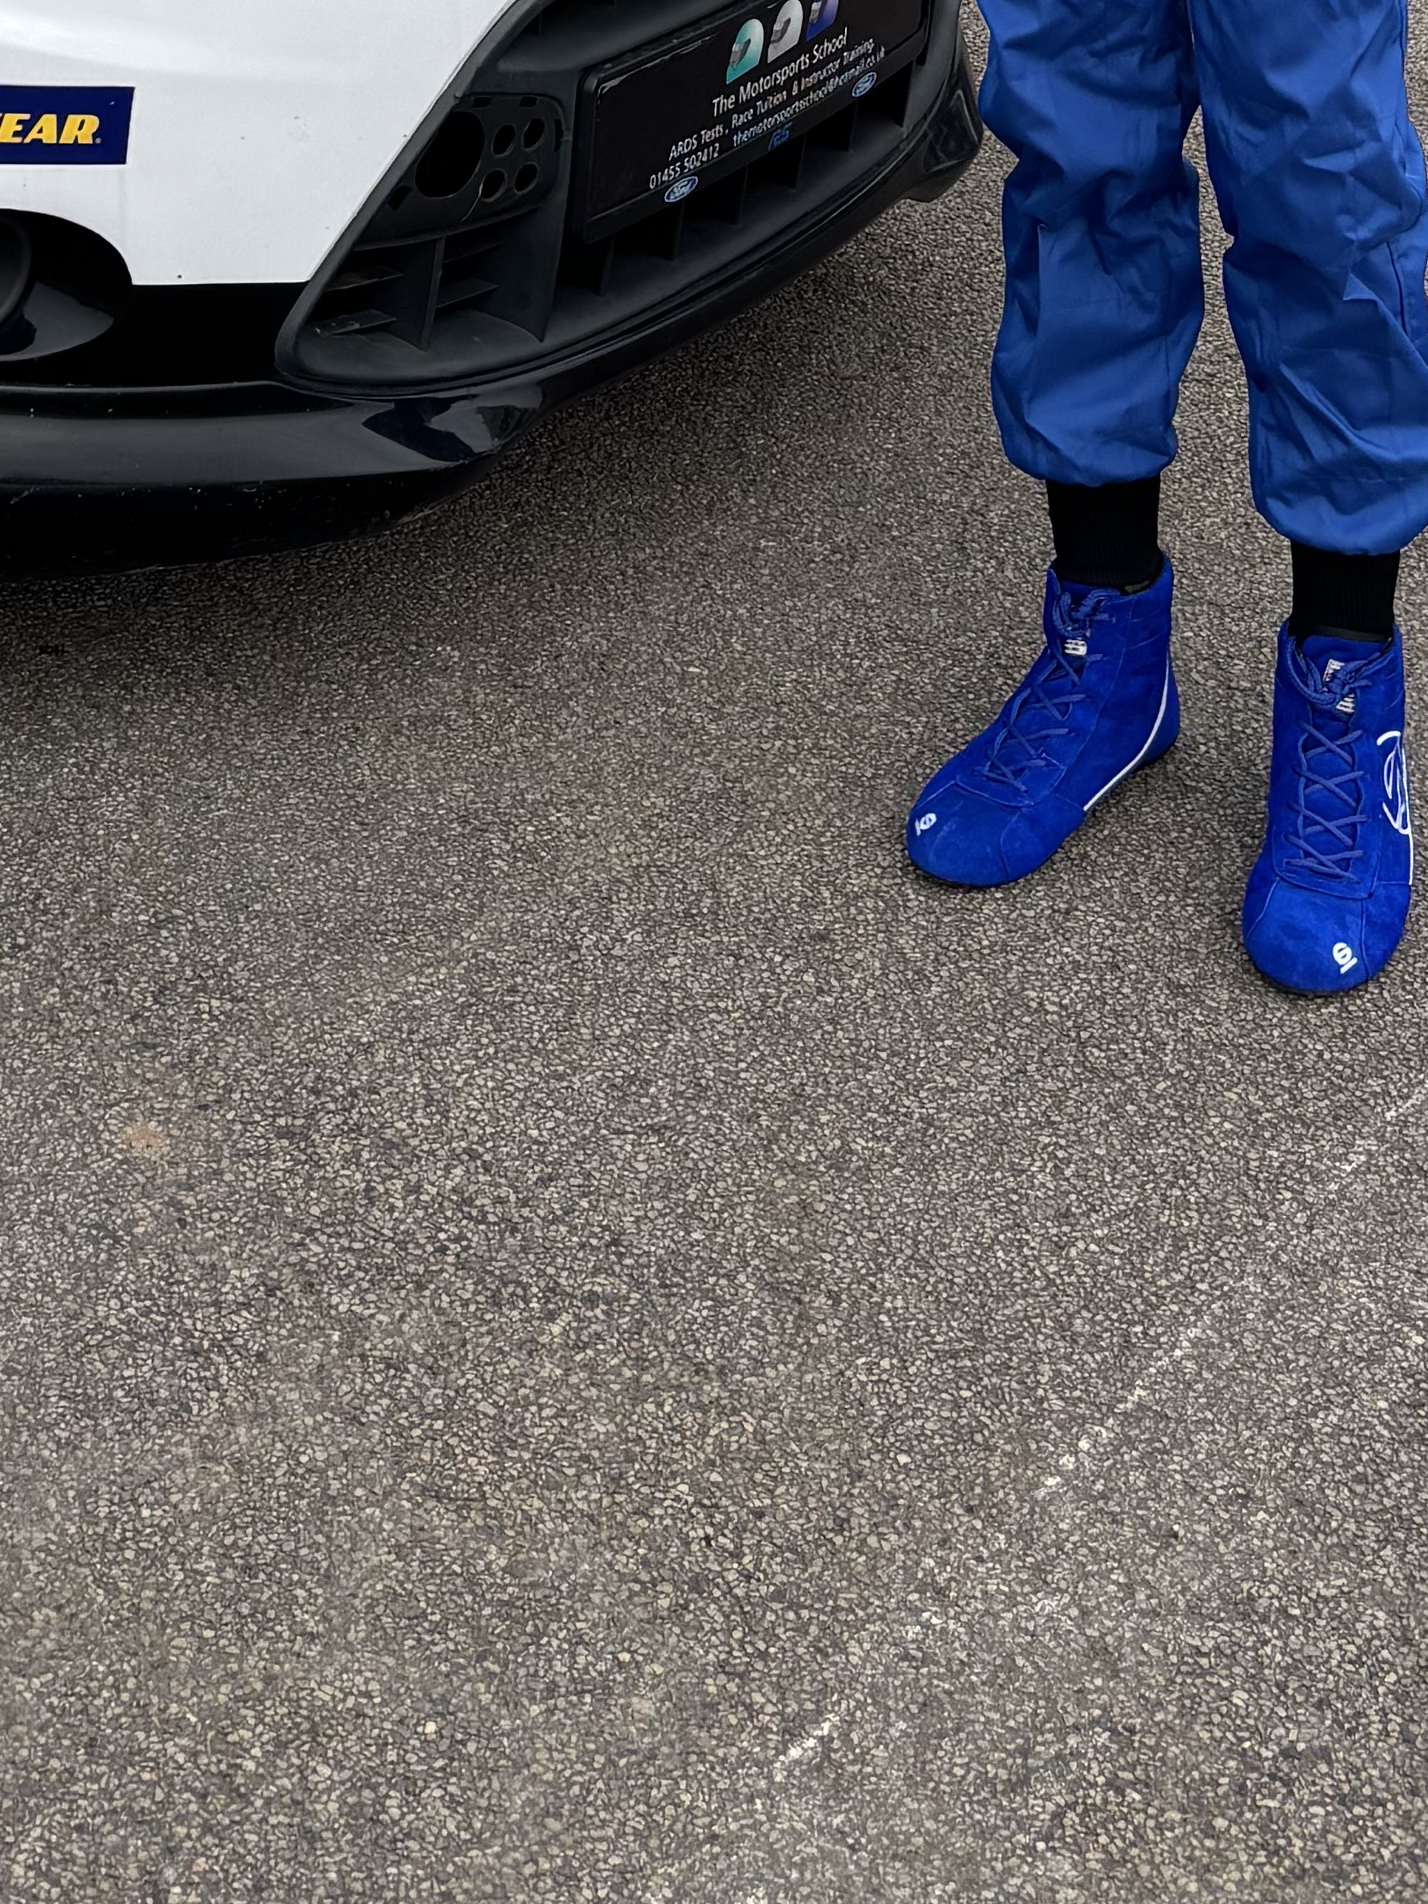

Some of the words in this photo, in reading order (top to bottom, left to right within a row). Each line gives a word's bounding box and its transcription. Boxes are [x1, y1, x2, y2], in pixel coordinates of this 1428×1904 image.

[712, 93, 736, 118] The
[739, 51, 810, 104] Motorsports
[812, 26, 848, 64] School
[668, 133, 698, 162] ARDS
[731, 108, 754, 129] Race
[649, 161, 682, 190] 01455
[683, 142, 720, 173] 502412
